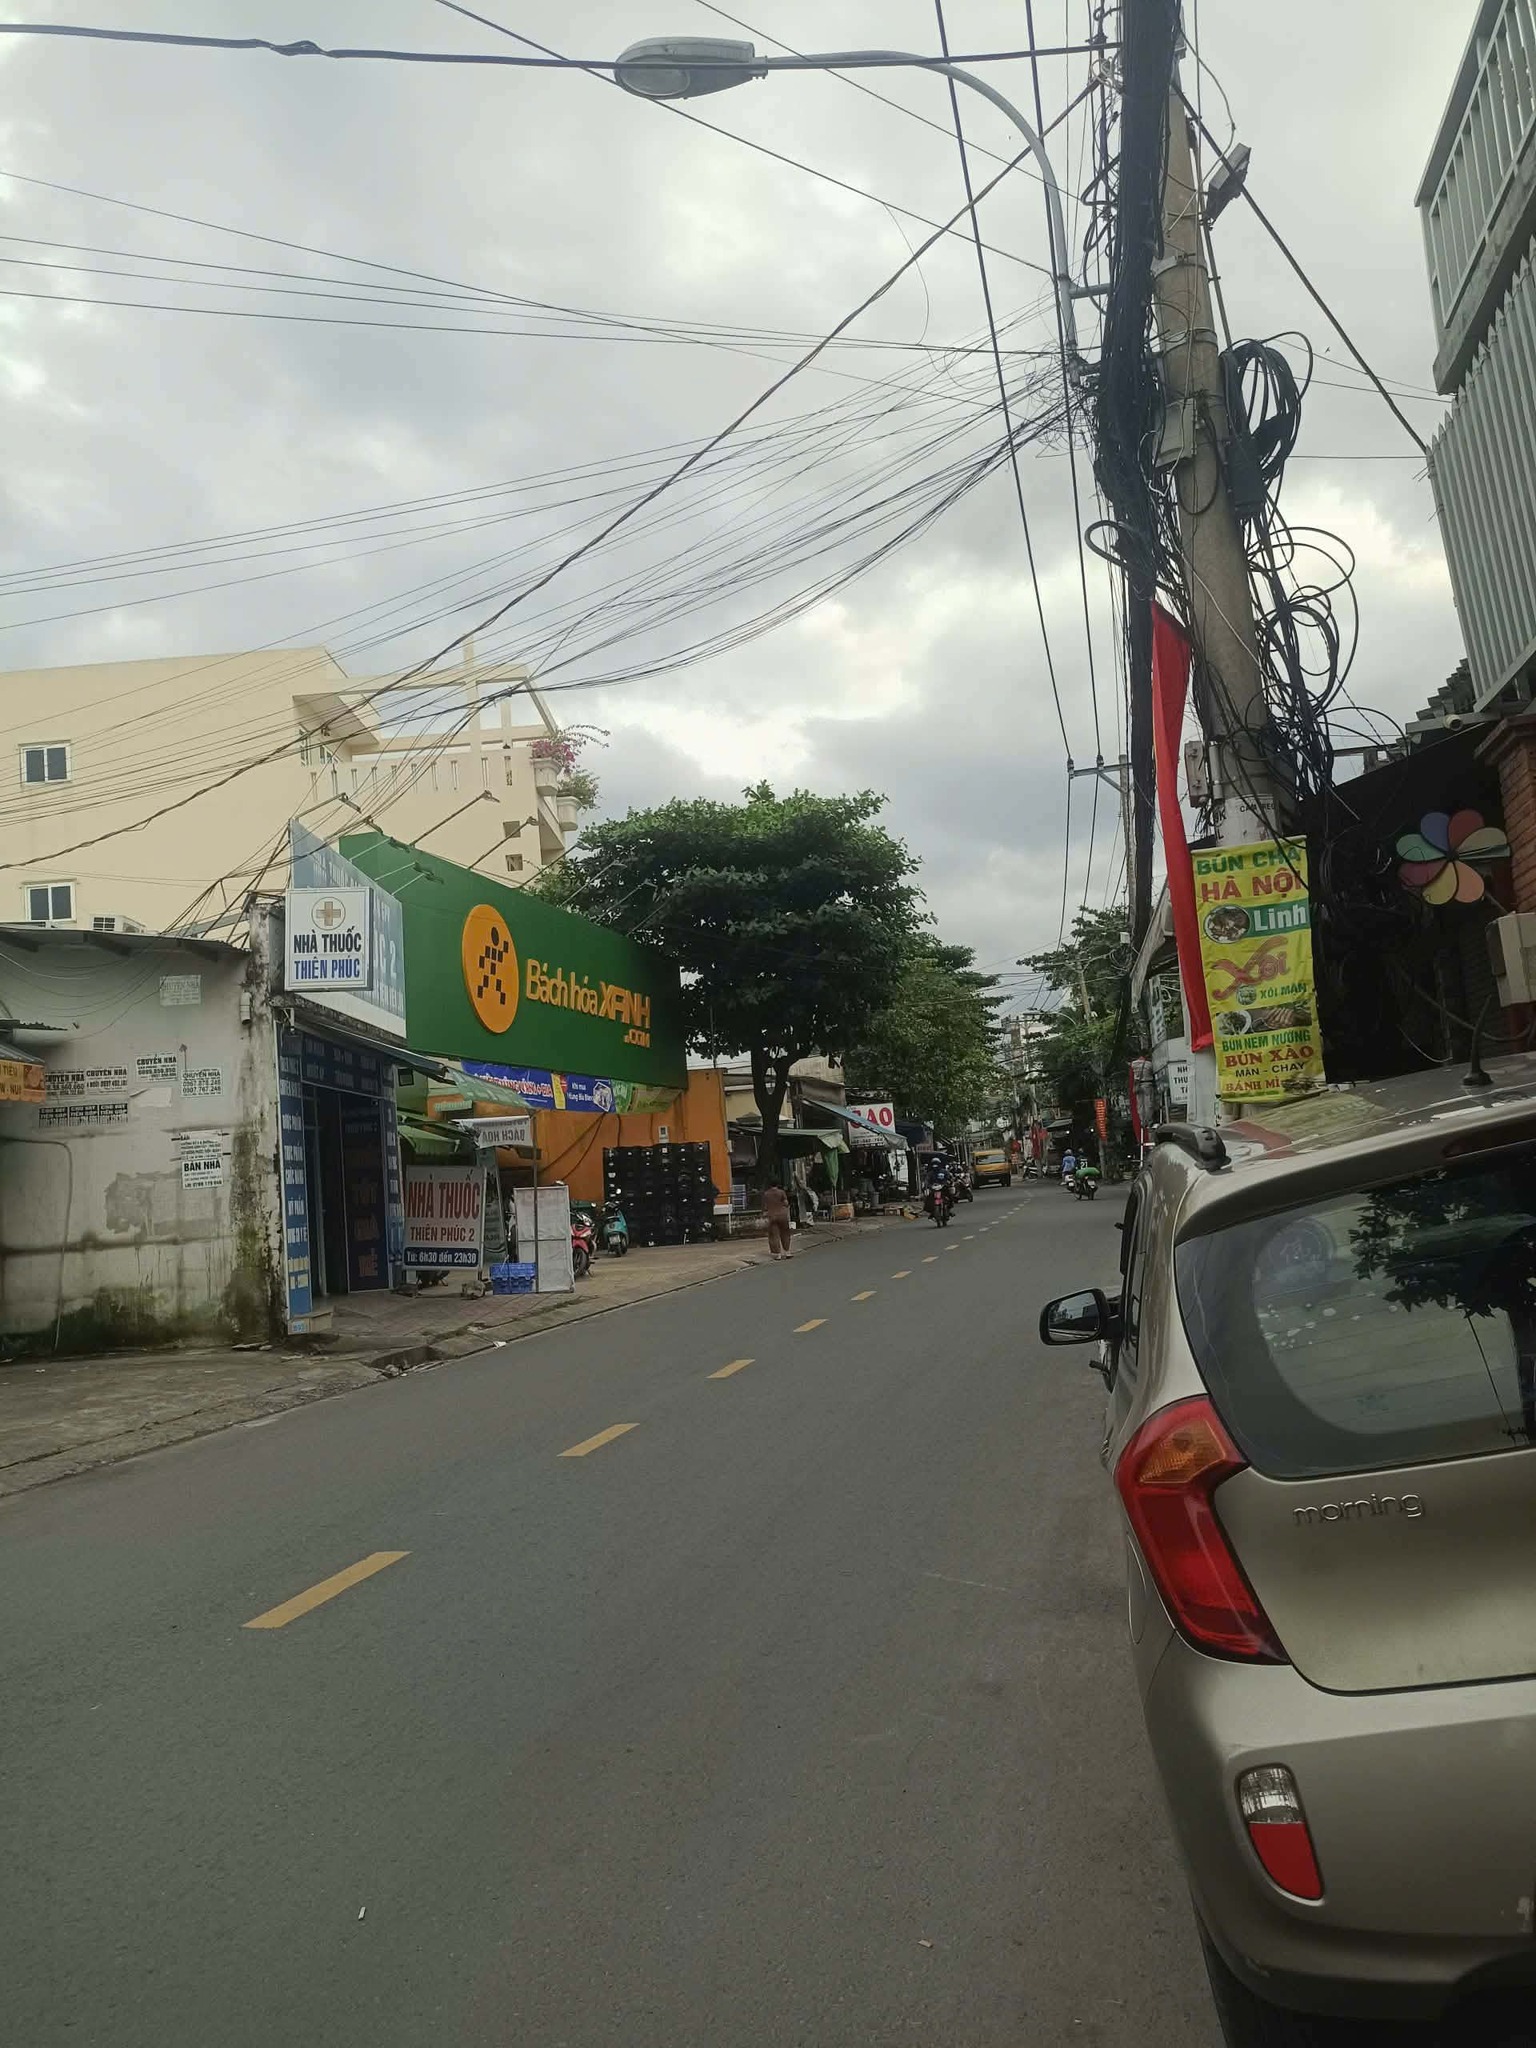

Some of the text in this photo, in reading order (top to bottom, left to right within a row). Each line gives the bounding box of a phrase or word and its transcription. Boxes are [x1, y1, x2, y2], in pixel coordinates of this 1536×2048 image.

[1196, 853, 1244, 876] BÚN
[1201, 867, 1305, 903] HÀ NỘI
[1254, 904, 1307, 932] Linh
[293, 929, 318, 953] NHÀ
[321, 926, 362, 953] THUỐC
[294, 955, 360, 979] THIÊN PHÚC
[526, 958, 651, 1029] Bách hóa XANH
[1244, 1035, 1269, 1050] NEM
[1225, 1044, 1315, 1069] BÚN XÀO
[1271, 1061, 1307, 1074] CHAY
[1173, 1077, 1188, 1085] THU
[1177, 1066, 1188, 1074] NH
[1226, 1078, 1262, 1092] BÁNH
[407, 1174, 434, 1218] NHÀ
[439, 1169, 480, 1219] THUỐC
[410, 1224, 475, 1241] THIÊN PHÚC 2
[454, 1252, 477, 1264] 23h30
[1293, 1493, 1425, 1526] morning
